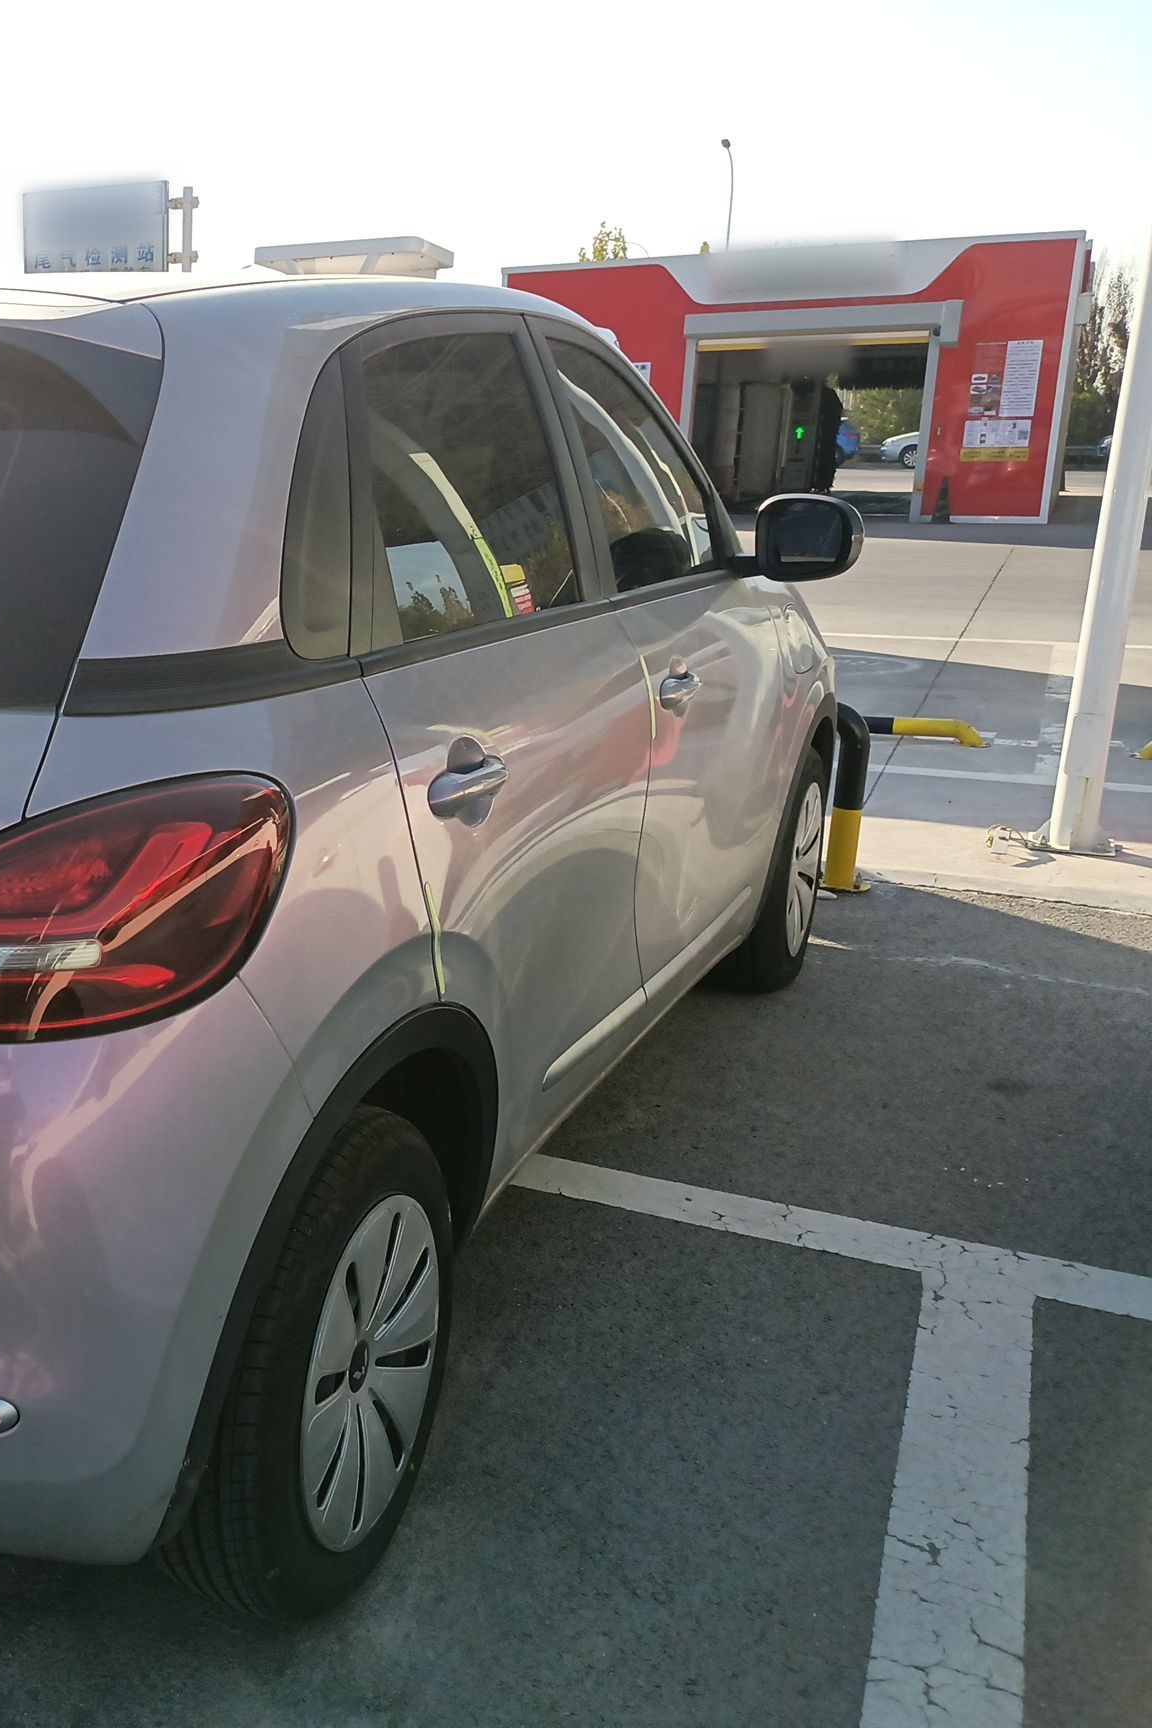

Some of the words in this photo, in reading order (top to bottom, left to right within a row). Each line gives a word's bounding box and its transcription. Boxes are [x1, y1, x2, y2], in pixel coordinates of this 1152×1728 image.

[34, 244, 155, 270] 尾气检测站
